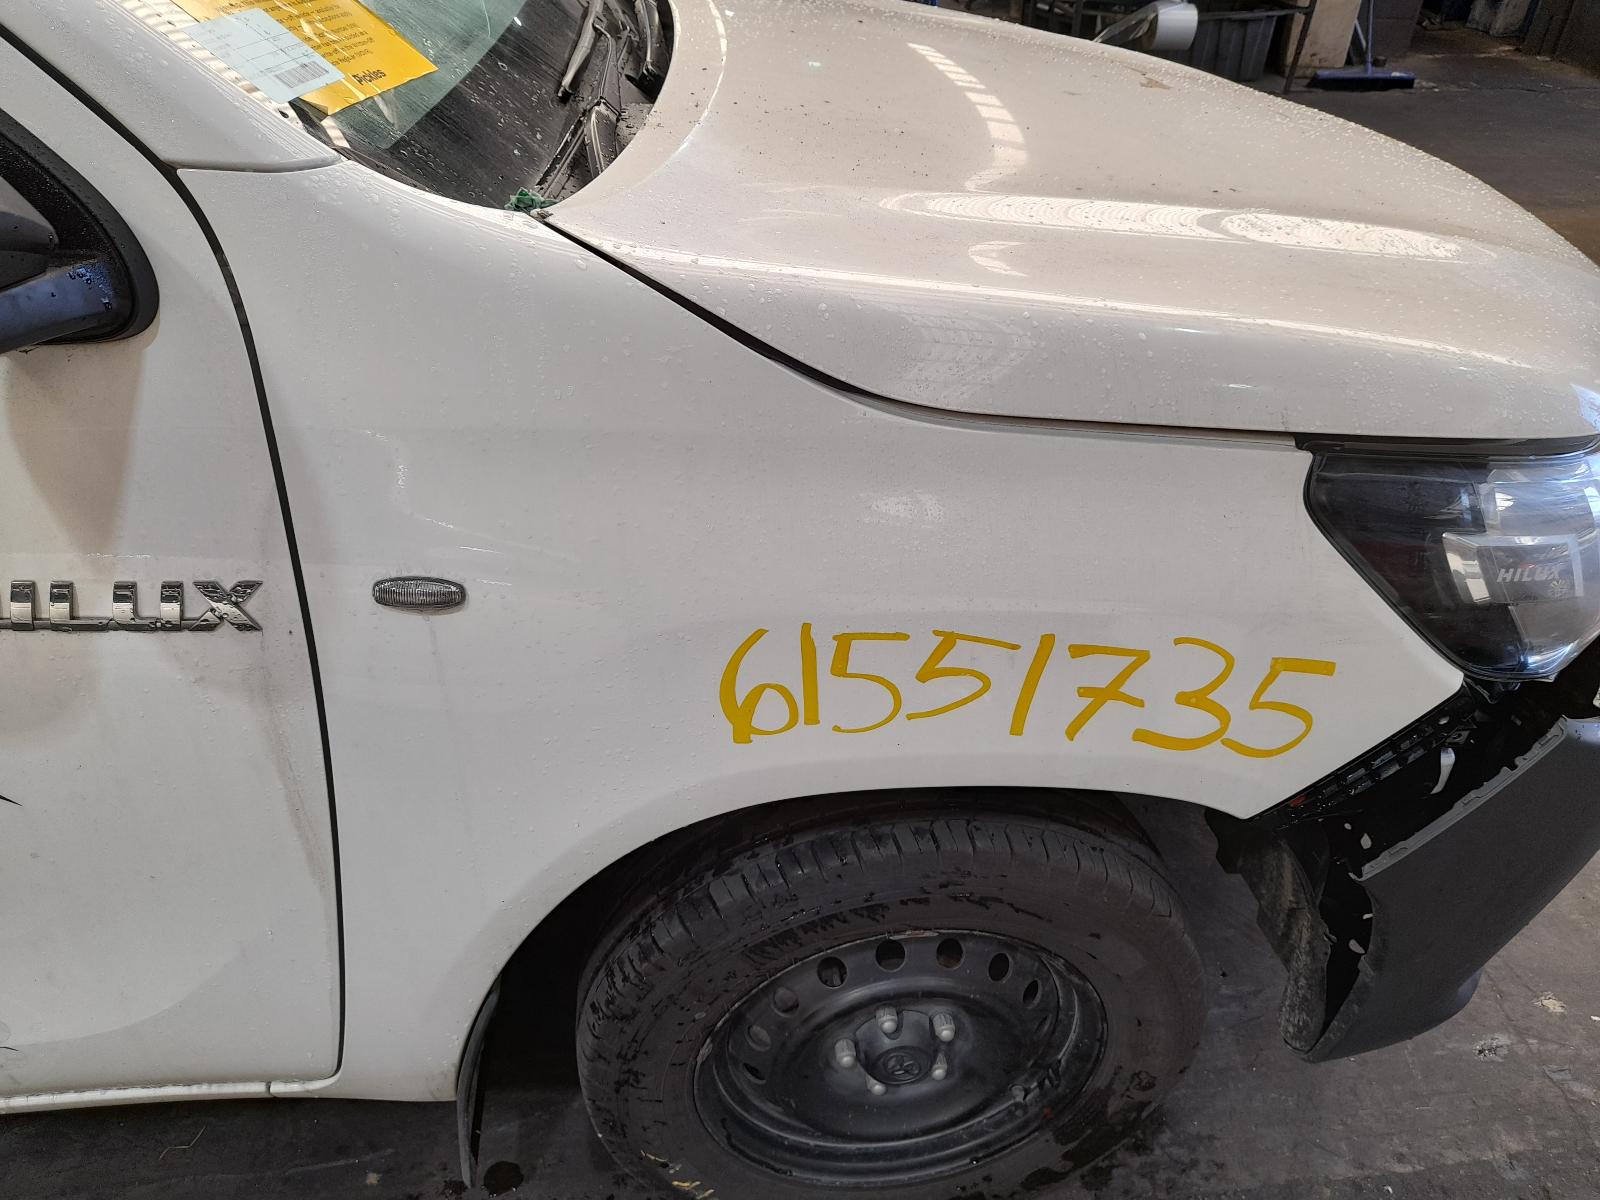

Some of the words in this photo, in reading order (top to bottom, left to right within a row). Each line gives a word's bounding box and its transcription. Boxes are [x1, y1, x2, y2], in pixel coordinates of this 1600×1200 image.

[1496, 565, 1561, 582] HILUX
[0, 580, 263, 631] ILUX
[719, 622, 1336, 758] 61551735
